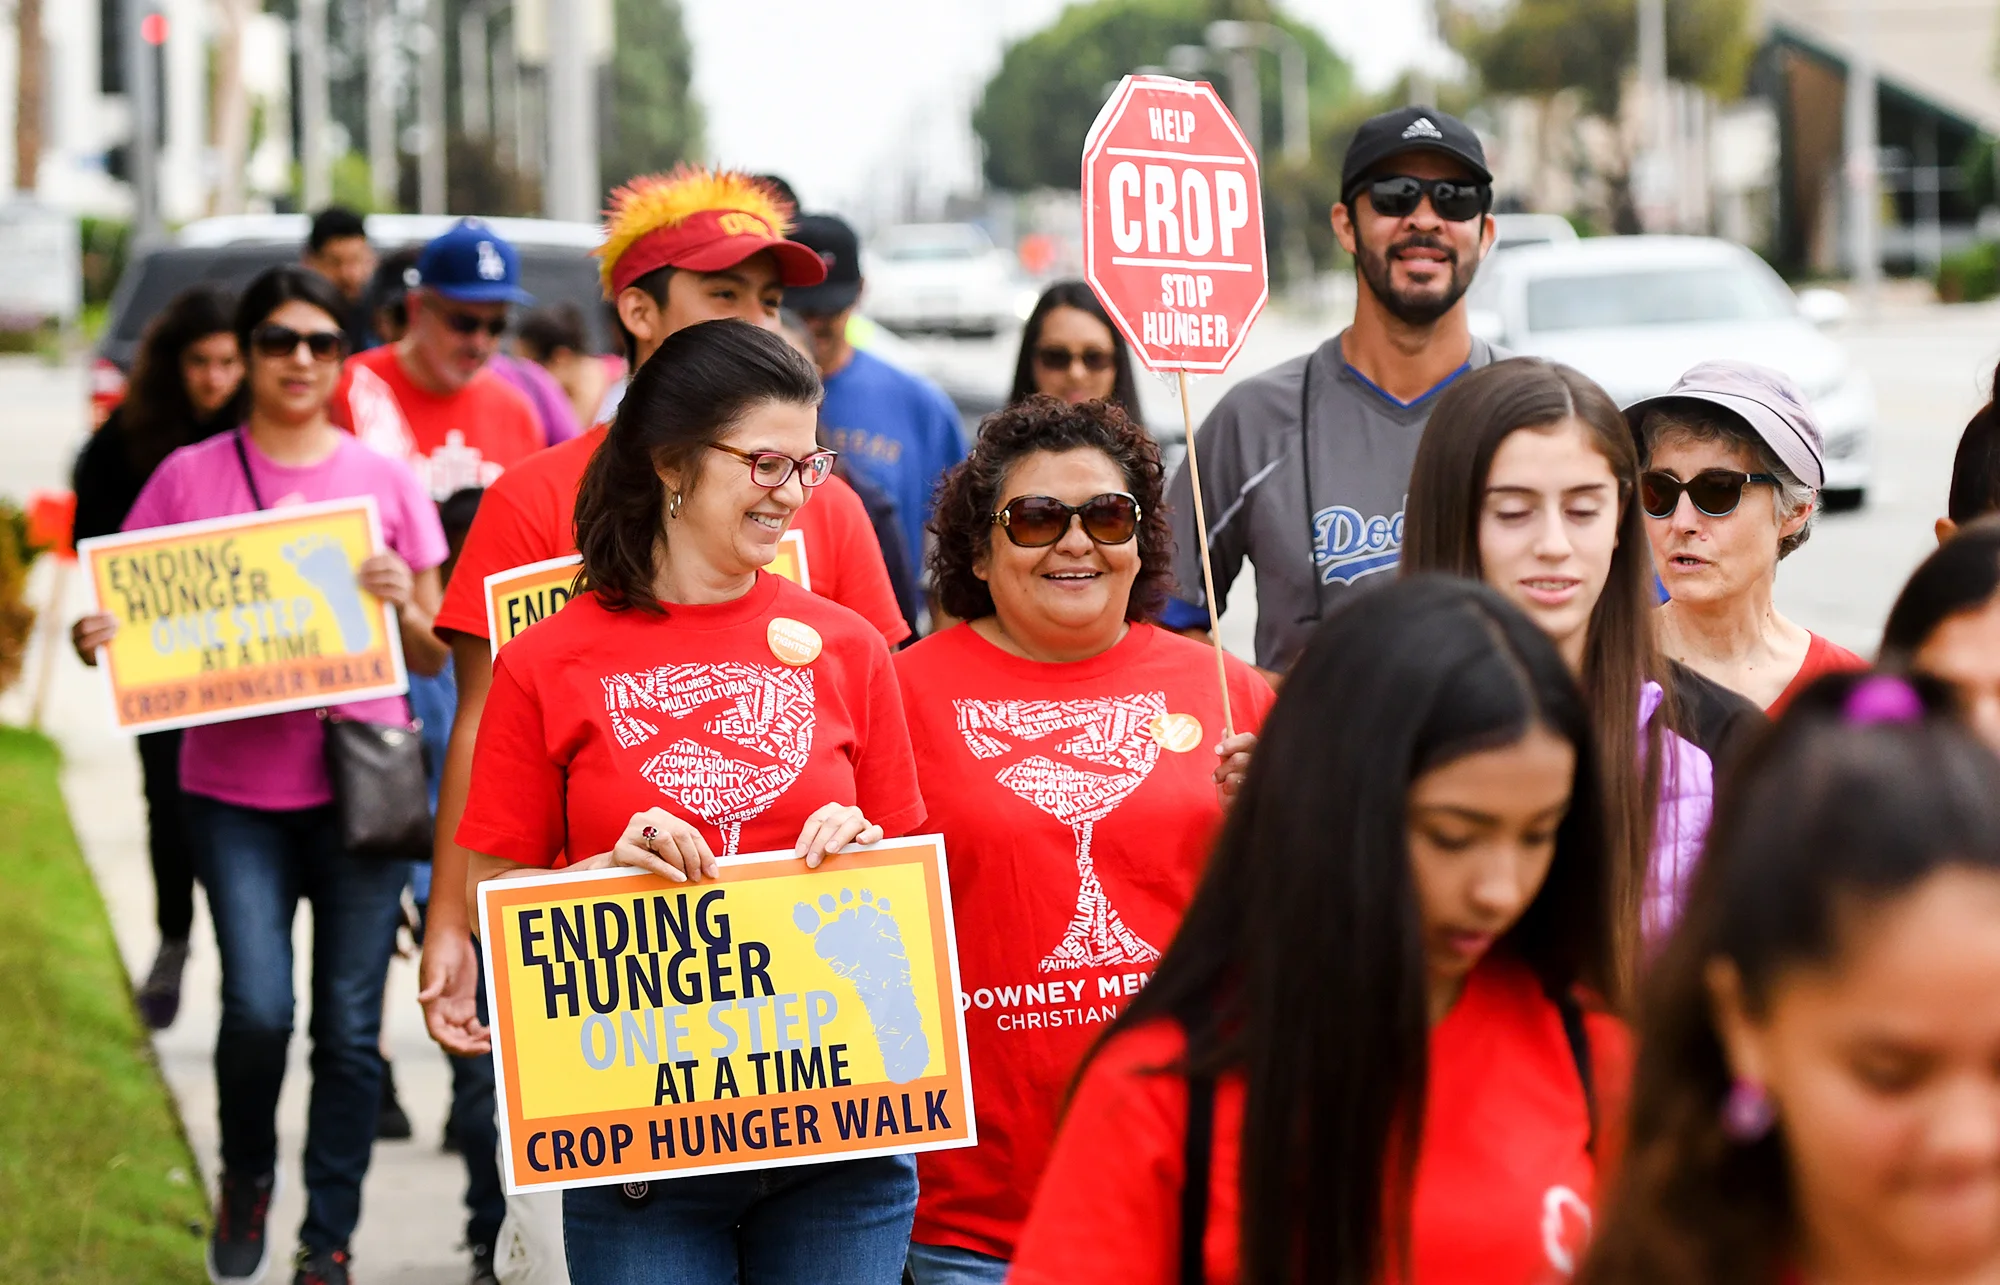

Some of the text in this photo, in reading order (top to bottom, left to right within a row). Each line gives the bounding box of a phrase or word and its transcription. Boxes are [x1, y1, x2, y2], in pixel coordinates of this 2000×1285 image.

[1148, 107, 1195, 143] HELP
[1109, 161, 1248, 256] CROP
[1161, 273, 1213, 307] STOP
[1142, 311, 1229, 347] HUNGER
[108, 538, 242, 592] ENDING
[124, 570, 271, 625] HUNGER
[151, 596, 314, 654] ONE STEP
[201, 630, 320, 671] AT A TIME
[121, 658, 385, 721] CROP HUNGER WALK
[622, 673, 658, 708] COMMUNITY
[659, 679, 752, 713] MULTICULTURAL
[669, 675, 712, 694] VALORES
[609, 711, 637, 747] FAMILY
[625, 717, 649, 742] PEOPLE
[711, 720, 766, 735] JESUS
[1011, 709, 1103, 737] MULTICULTURAL
[1021, 709, 1062, 724] VALORES
[673, 743, 710, 757] FAMILY
[778, 745, 808, 769] GOD
[961, 730, 994, 758] FAMILY
[1062, 740, 1117, 754] JESUS
[655, 773, 745, 788] COMMUNITY
[662, 755, 734, 772] COMPASIÓN
[1016, 765, 1084, 782] COMPASIÓN
[1026, 758, 1061, 769] FAMILY
[1126, 757, 1154, 774] GOD
[681, 788, 714, 805] GOD
[698, 764, 799, 820] MULTICULTURAL
[1011, 781, 1094, 792] COMMUNITY
[1034, 791, 1066, 805] GOD
[1052, 773, 1145, 820] MULTICULTURAL
[713, 805, 765, 825] LEADERSHIP
[1066, 805, 1113, 825] LEADERSHIP
[727, 821, 742, 856] MPASIÓN
[1079, 820, 1093, 865] COMPASIÓN
[1070, 877, 1101, 938] VALORES
[1096, 893, 1107, 952] LEADERSHIP
[518, 889, 731, 967] ENDING
[1109, 918, 1139, 956] VALORES
[1041, 960, 1075, 969] FAITH
[1062, 935, 1086, 960] GOD
[543, 941, 776, 1019] HUNGER
[580, 990, 838, 1071] ONE STEP
[997, 1004, 1117, 1031] CHRISTIAN
[654, 1043, 852, 1107] AT A TIME
[526, 1089, 952, 1173] CROP HUNGER WALK
